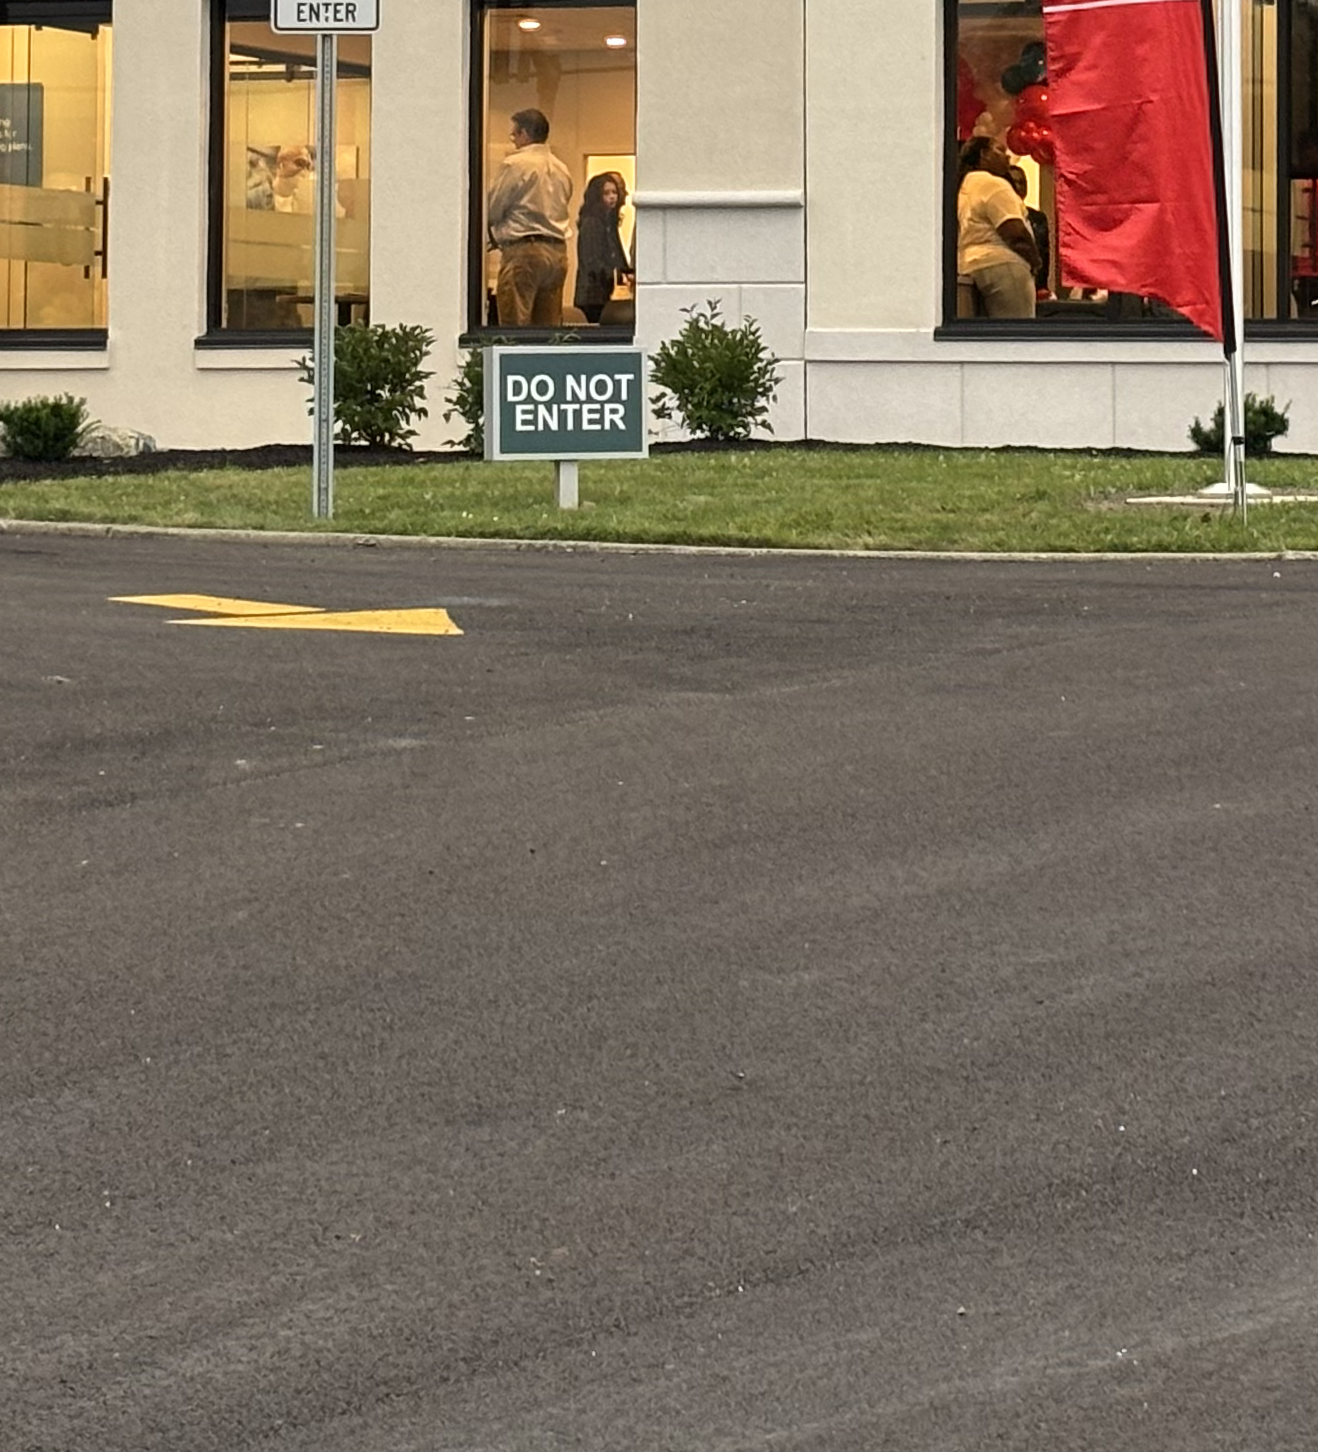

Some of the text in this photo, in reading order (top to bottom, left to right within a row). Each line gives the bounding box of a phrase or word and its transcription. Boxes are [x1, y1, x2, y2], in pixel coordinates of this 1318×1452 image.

[297, 2, 357, 23] ENTER
[506, 373, 634, 402] DO NOT
[515, 403, 626, 431] ENTER
